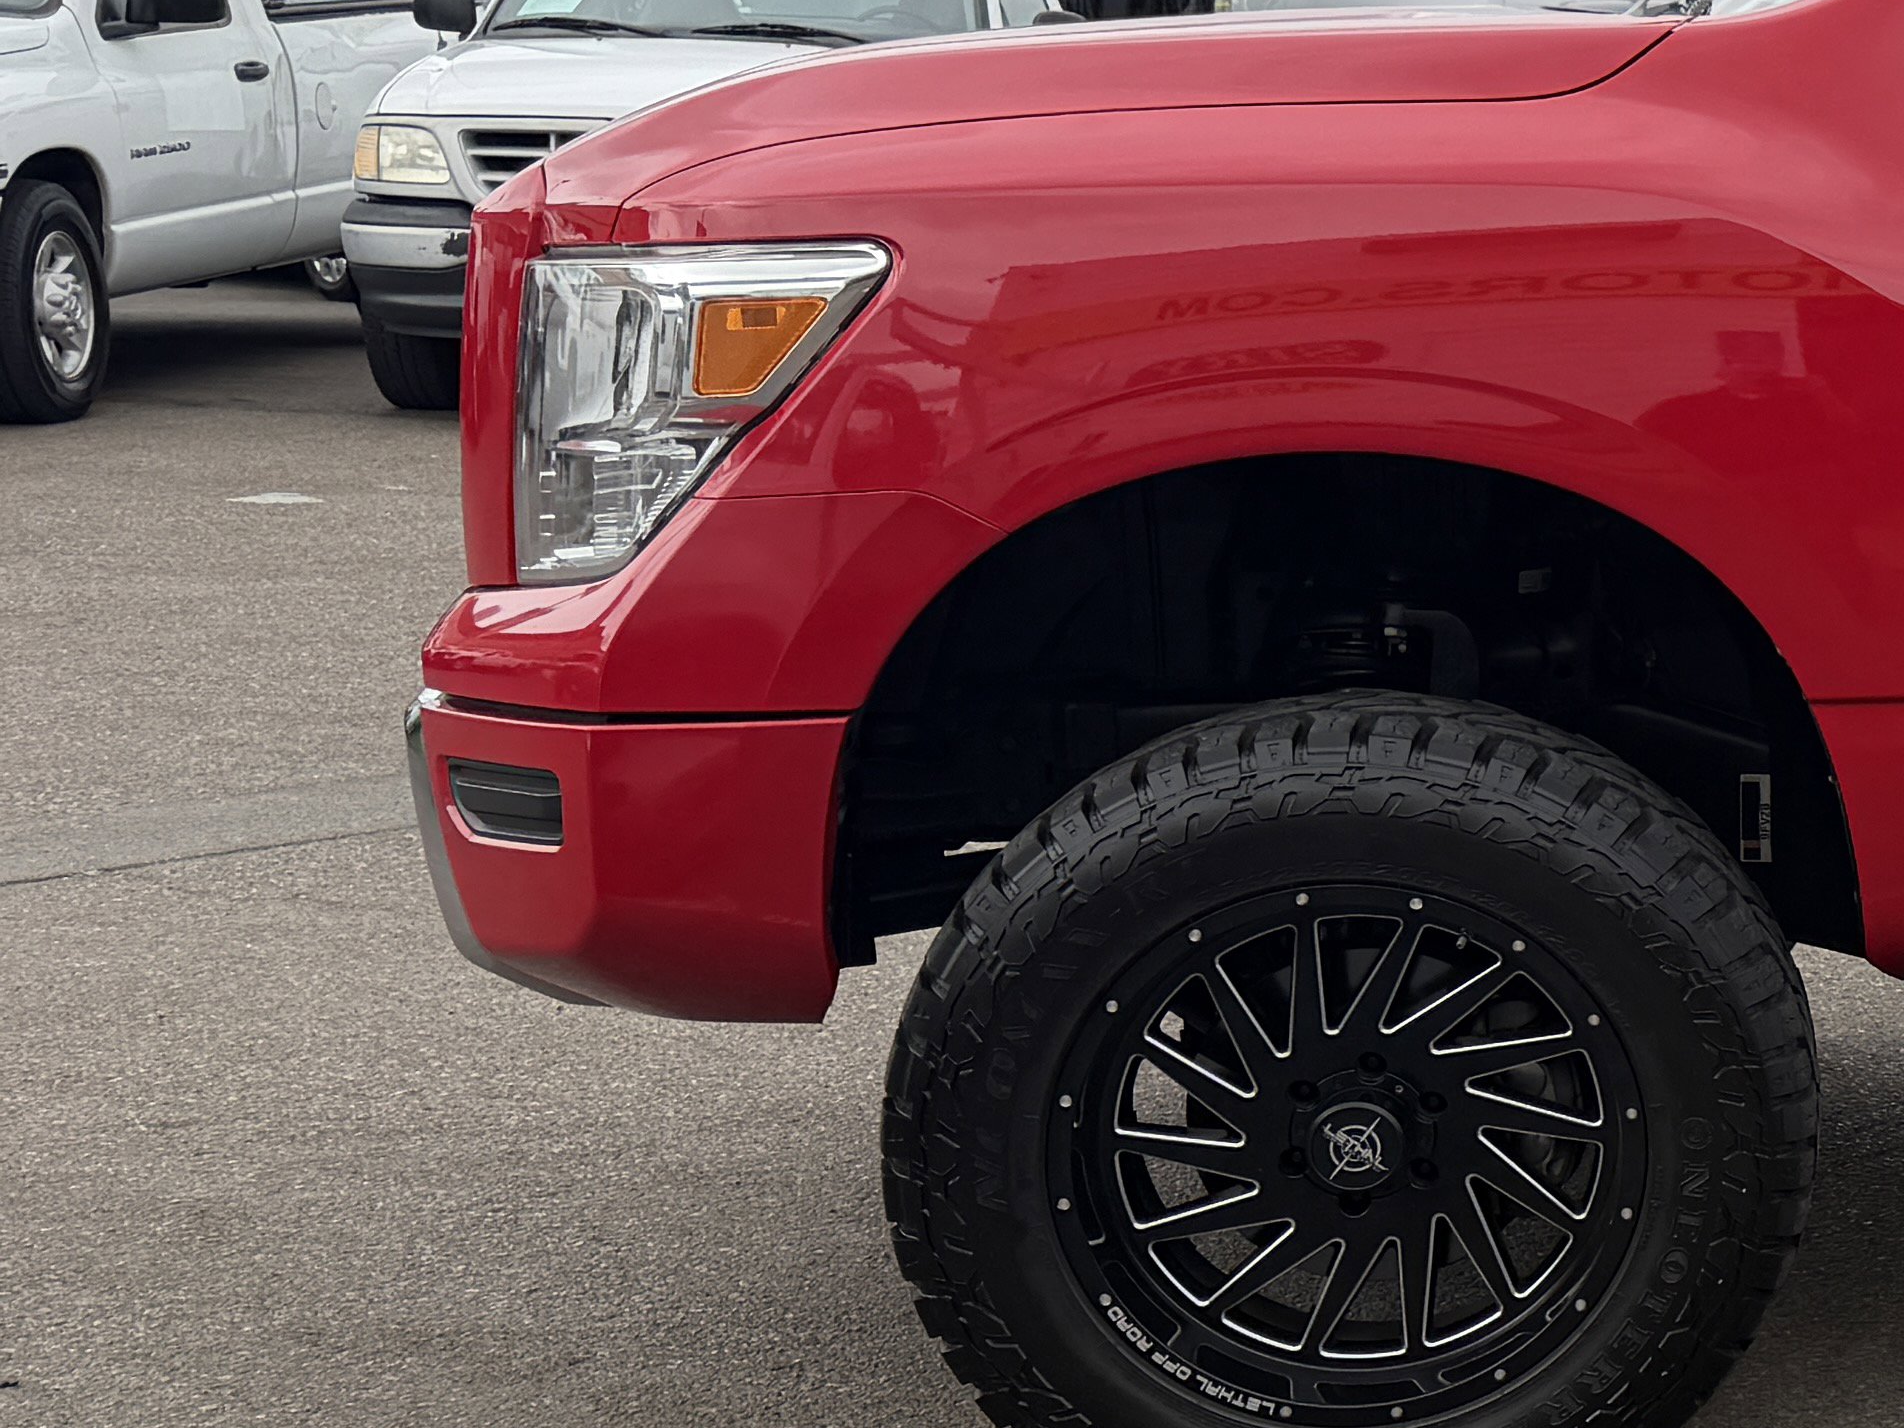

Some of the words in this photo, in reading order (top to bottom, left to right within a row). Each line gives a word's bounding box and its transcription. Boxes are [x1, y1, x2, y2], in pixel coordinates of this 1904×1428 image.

[1107, 1305, 1154, 1352] ROAD
[1151, 1351, 1192, 1381] OFF
[1196, 1374, 1275, 1416] LETHAL
